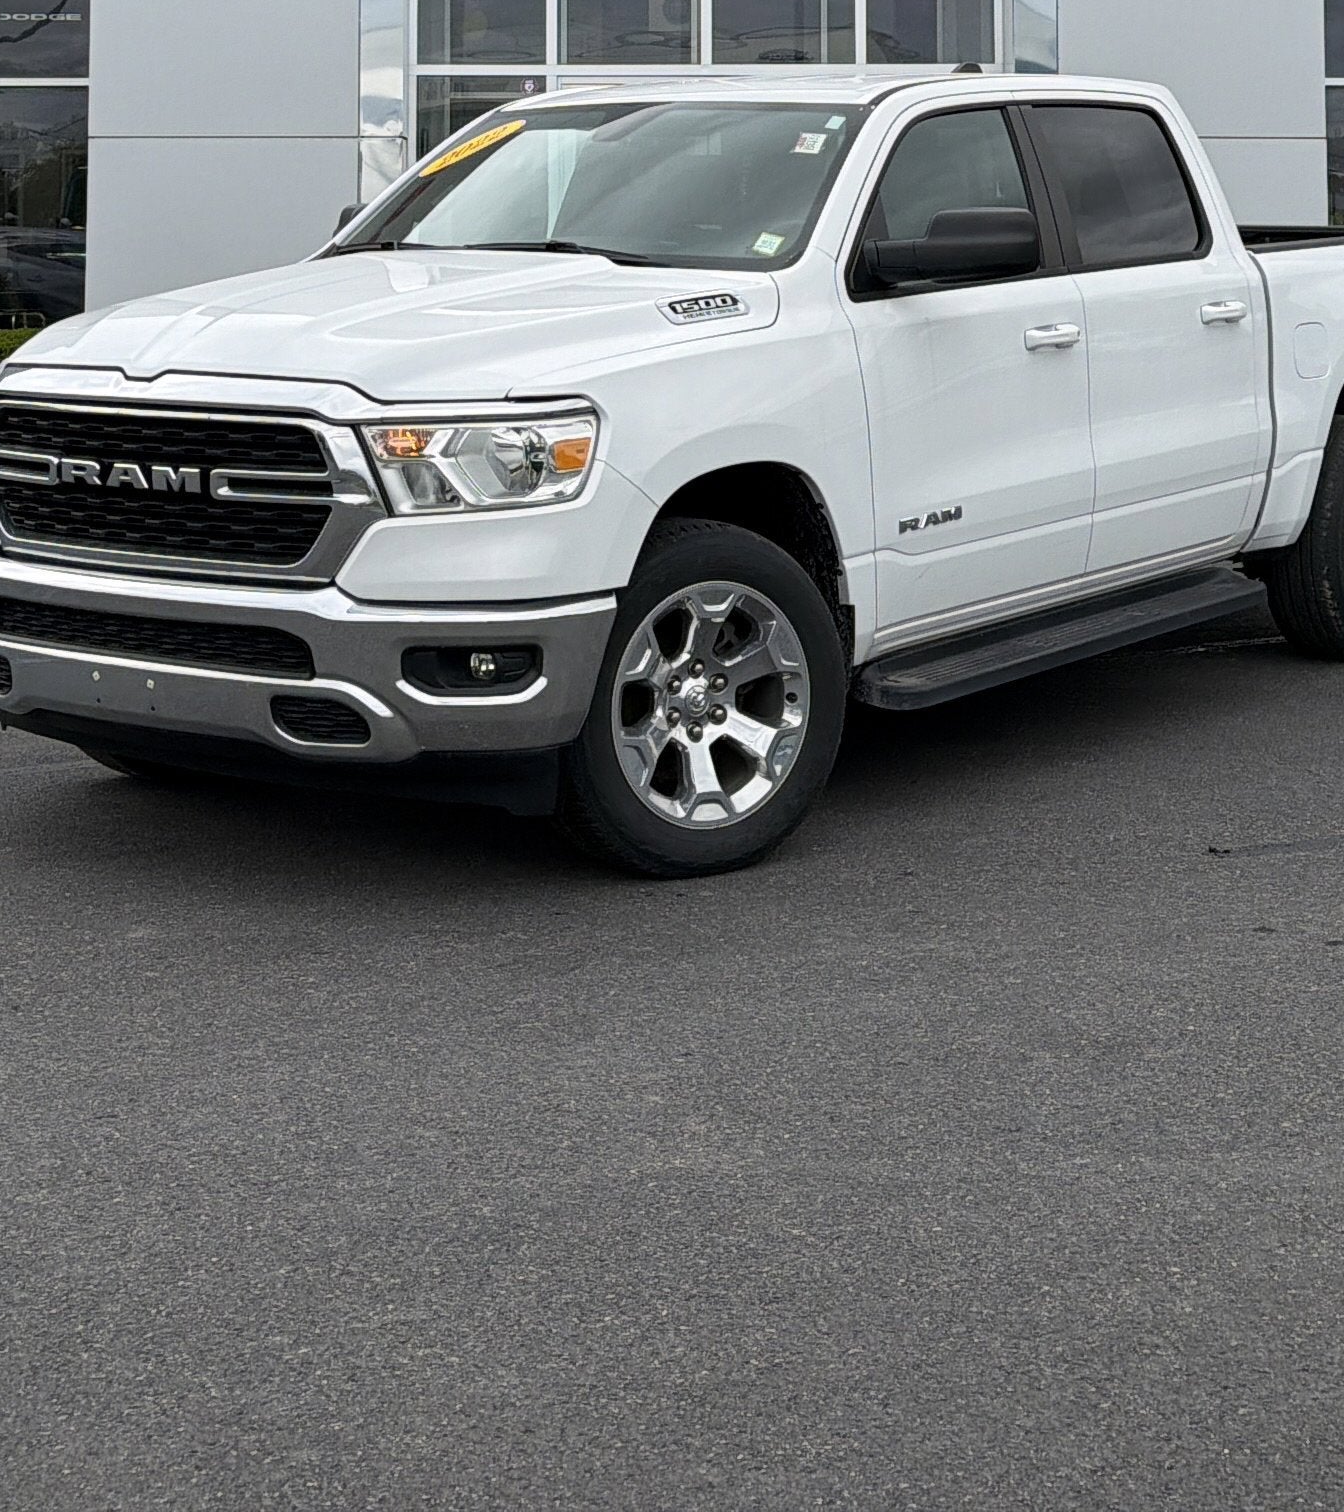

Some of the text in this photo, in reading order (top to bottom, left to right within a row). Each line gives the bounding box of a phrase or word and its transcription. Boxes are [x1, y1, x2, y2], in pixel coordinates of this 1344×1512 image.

[0, 13, 82, 21] DODGE
[670, 295, 733, 314] 1500
[60, 458, 202, 494] RAM
[899, 505, 962, 535] RAM
